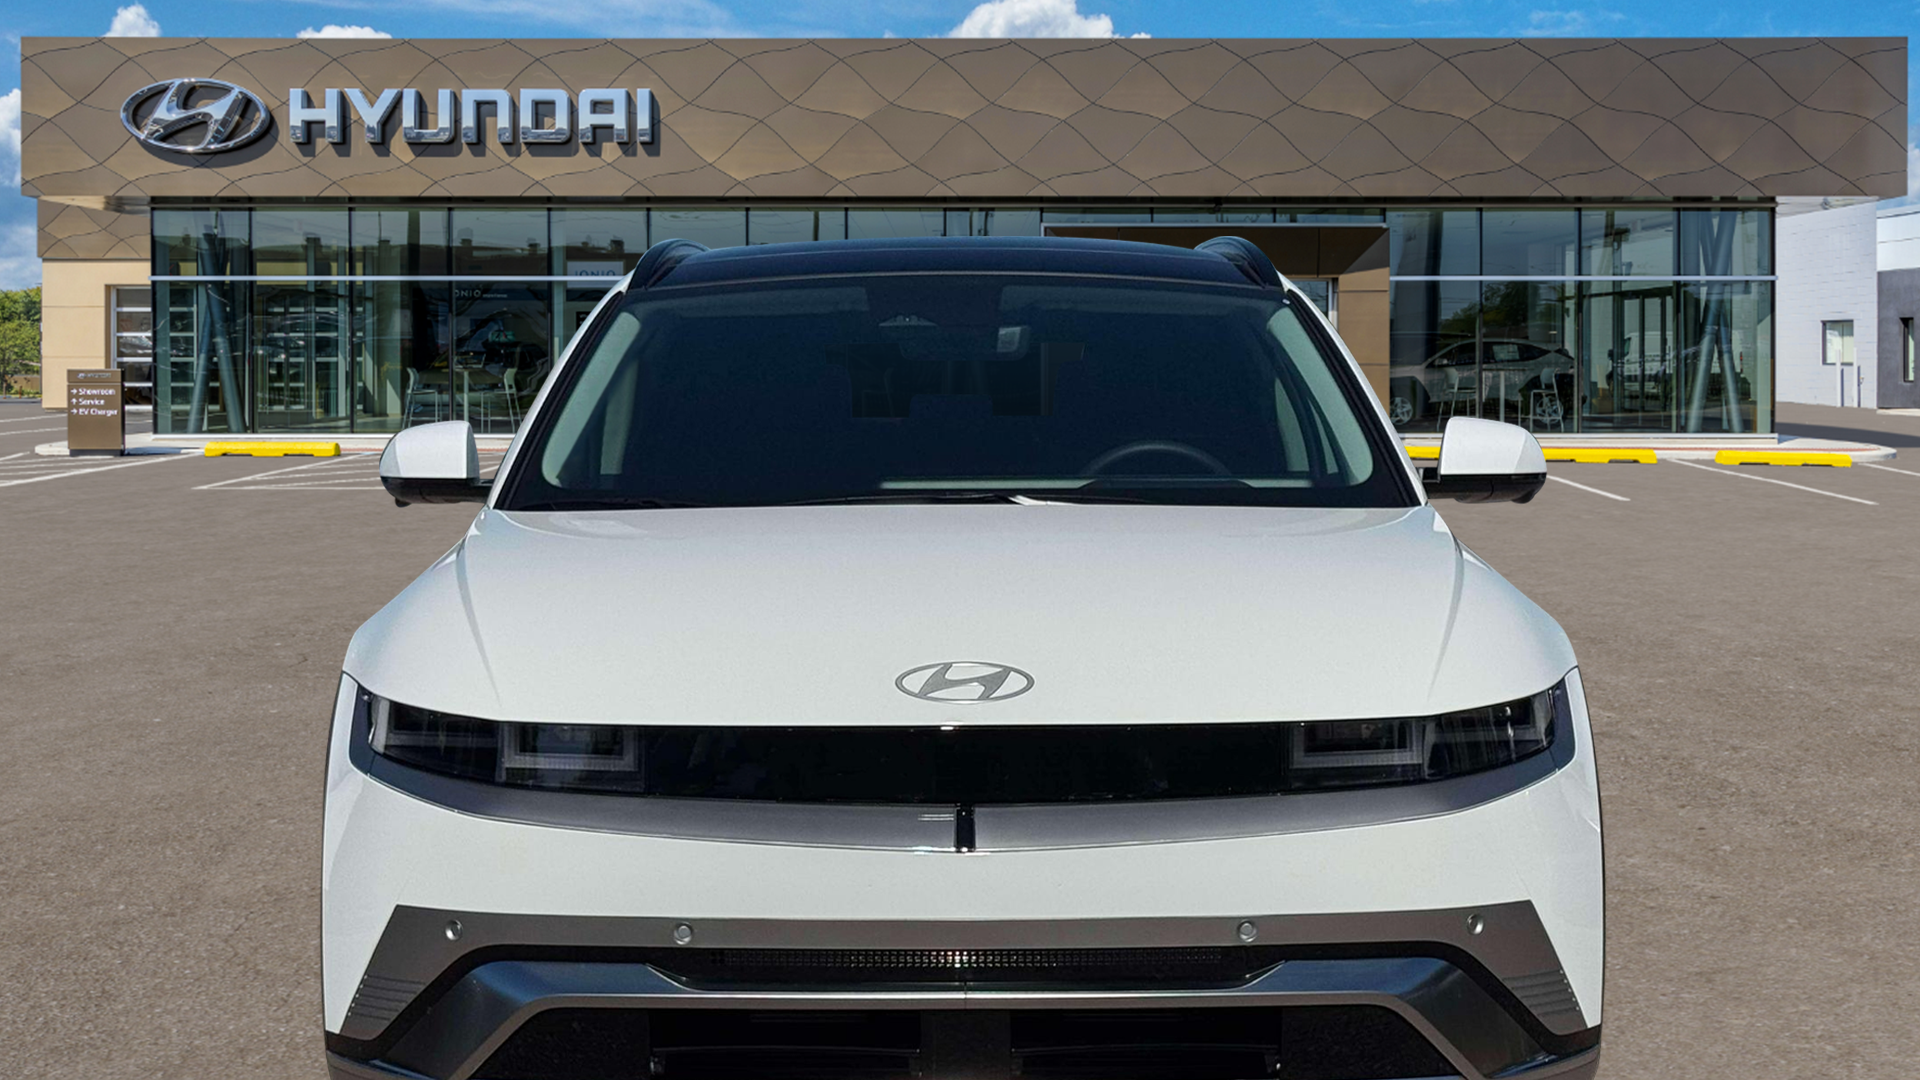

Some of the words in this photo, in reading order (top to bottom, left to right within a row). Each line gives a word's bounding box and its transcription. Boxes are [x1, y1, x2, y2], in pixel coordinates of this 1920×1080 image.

[289, 88, 653, 144] HYUNDAI
[78, 387, 116, 395] Showroom
[78, 397, 105, 405] Service
[90, 408, 118, 417] Charger
